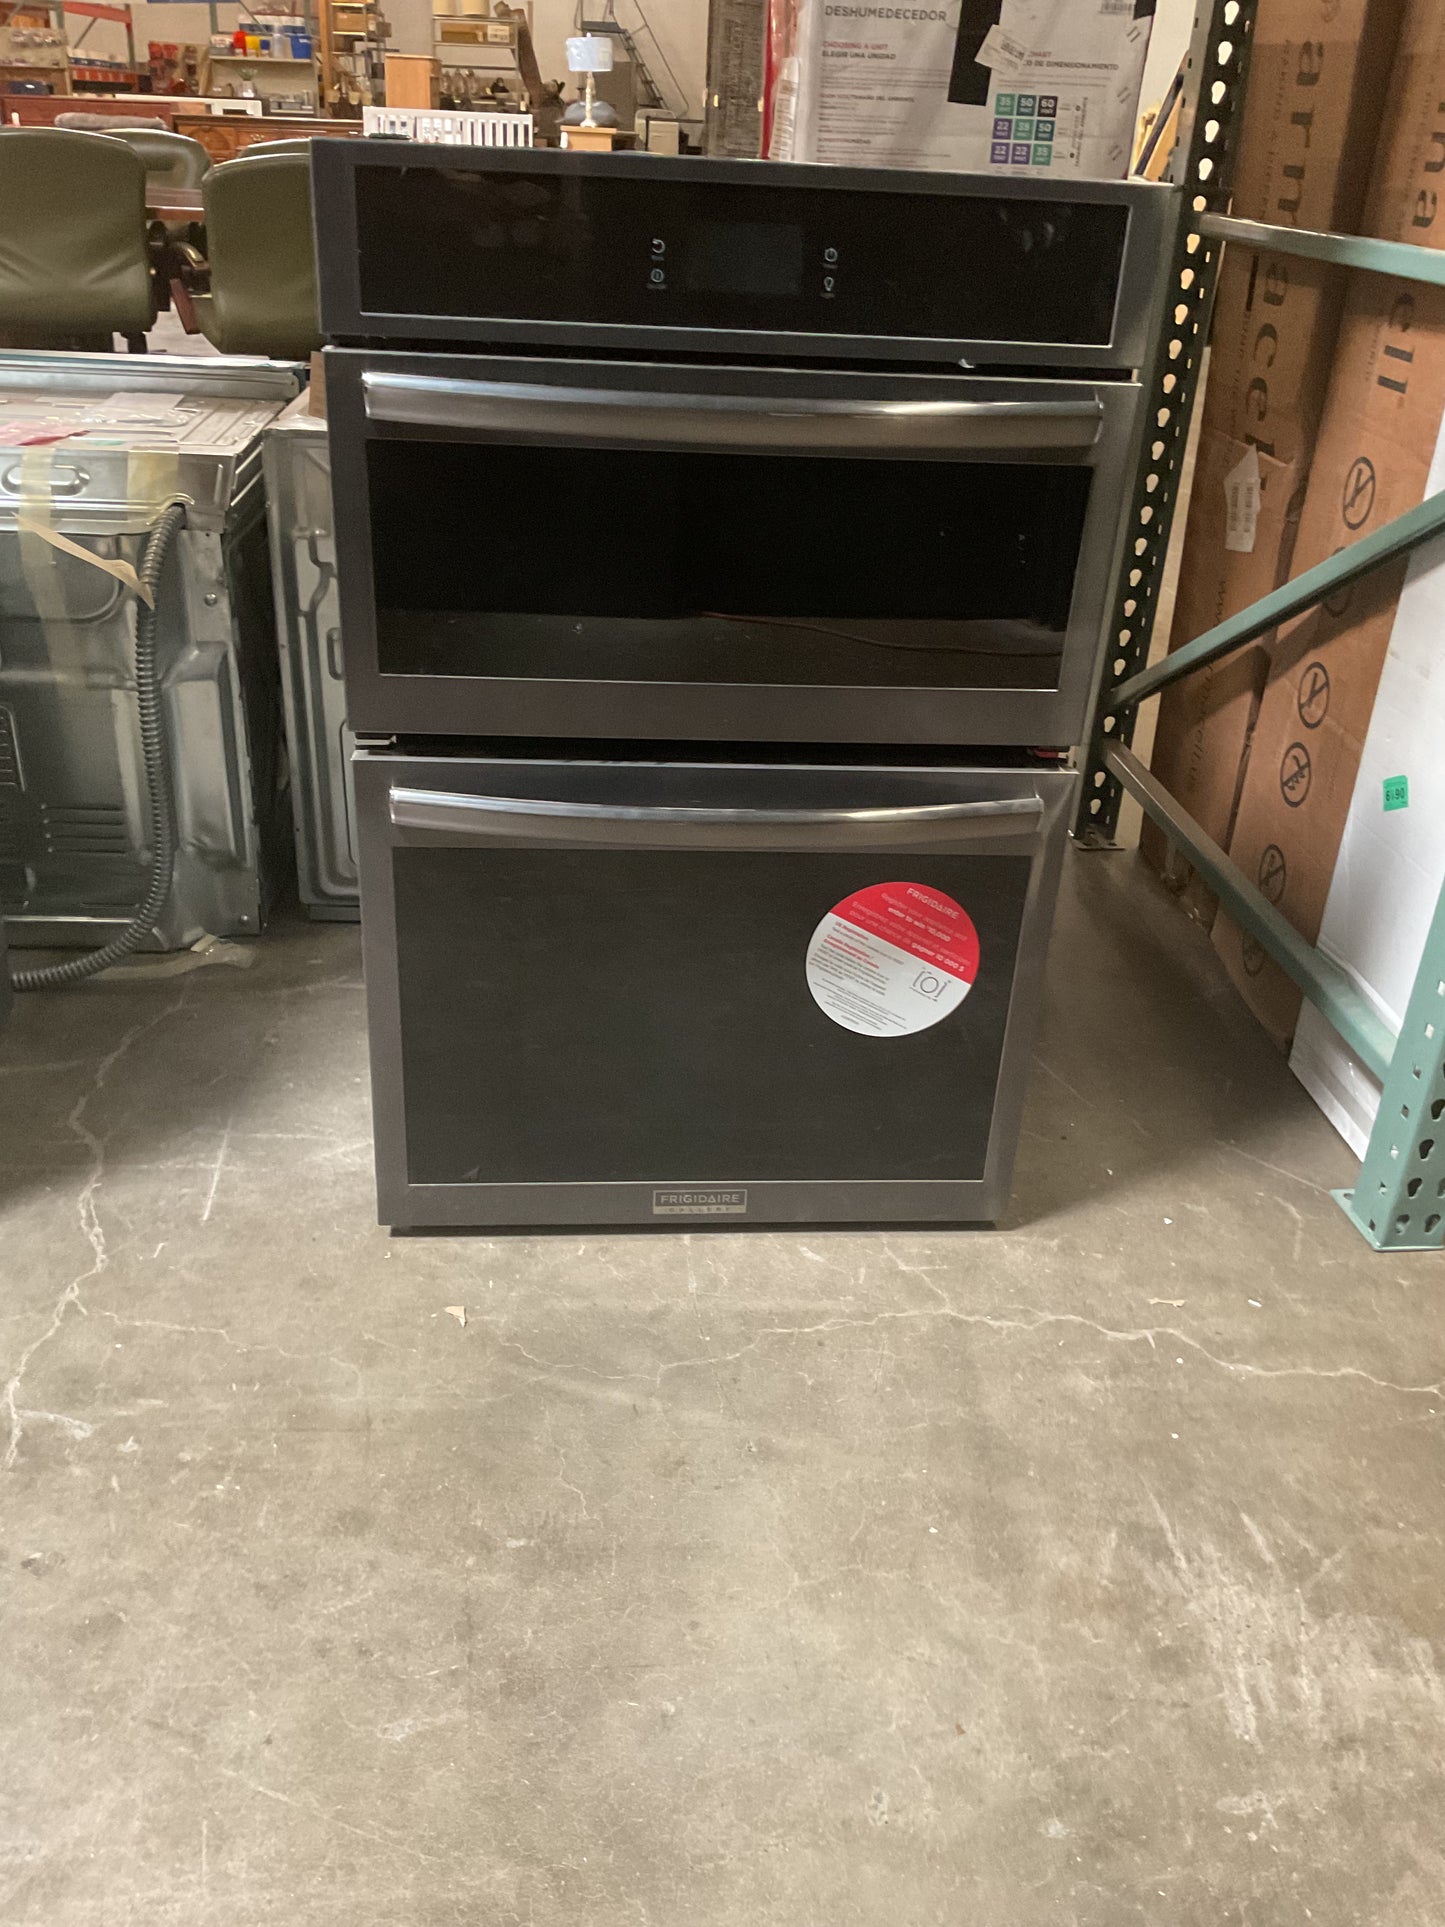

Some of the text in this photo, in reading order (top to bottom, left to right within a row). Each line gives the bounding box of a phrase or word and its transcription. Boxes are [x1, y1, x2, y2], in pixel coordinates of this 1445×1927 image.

[825, 5, 947, 21] DESHUMEDECEDOR
[822, 50, 896, 60] ELEGIR UNA UNIDAD
[1046, 61, 1119, 71] DIMENSIONAMIENTO
[1020, 97, 1034, 107] 50
[1041, 98, 1055, 108] 60
[1038, 123, 1052, 132] 50
[905, 887, 959, 919] FRIGIDAIRE
[661, 1194, 740, 1204] FRIGIDAIRE
